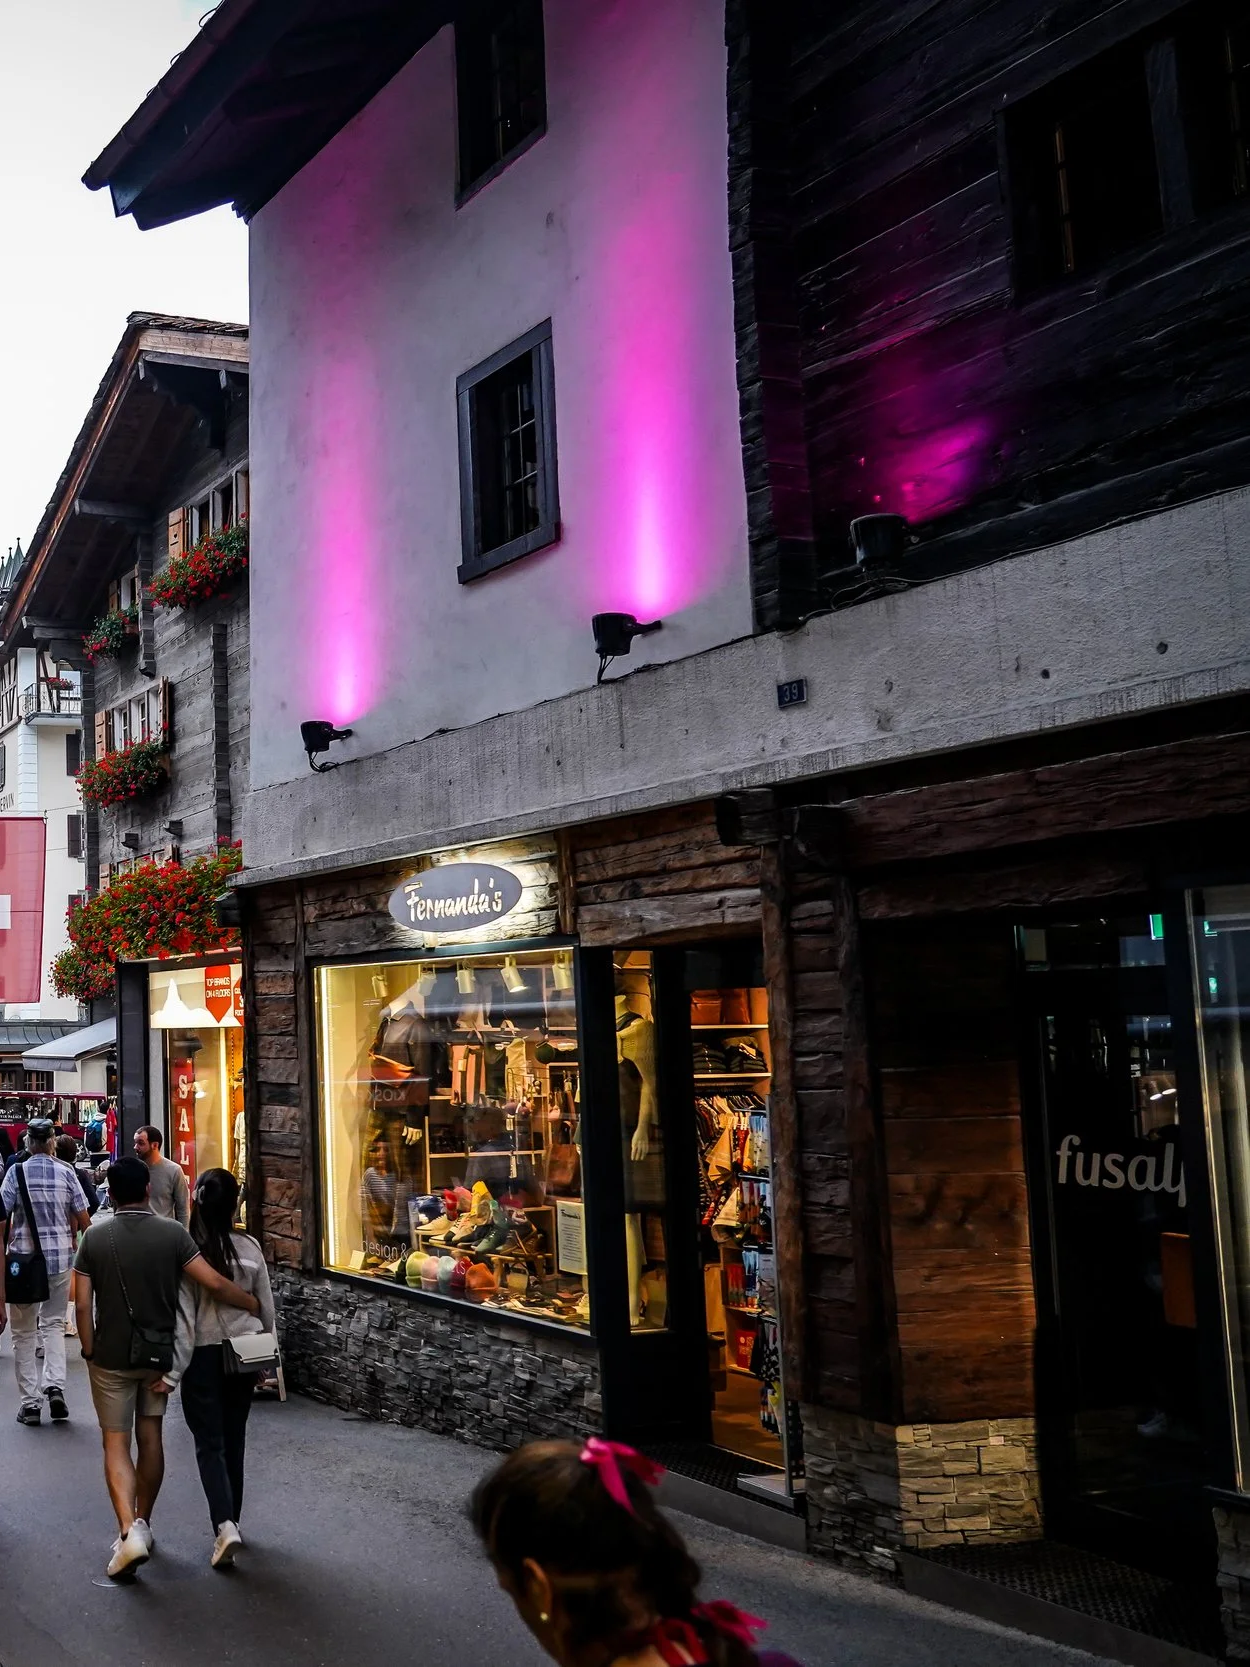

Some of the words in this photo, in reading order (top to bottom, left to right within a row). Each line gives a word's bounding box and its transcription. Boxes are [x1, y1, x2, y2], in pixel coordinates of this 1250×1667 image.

[783, 683, 799, 701] 39
[403, 878, 502, 922] Fernanda's
[362, 1238, 398, 1261] design
